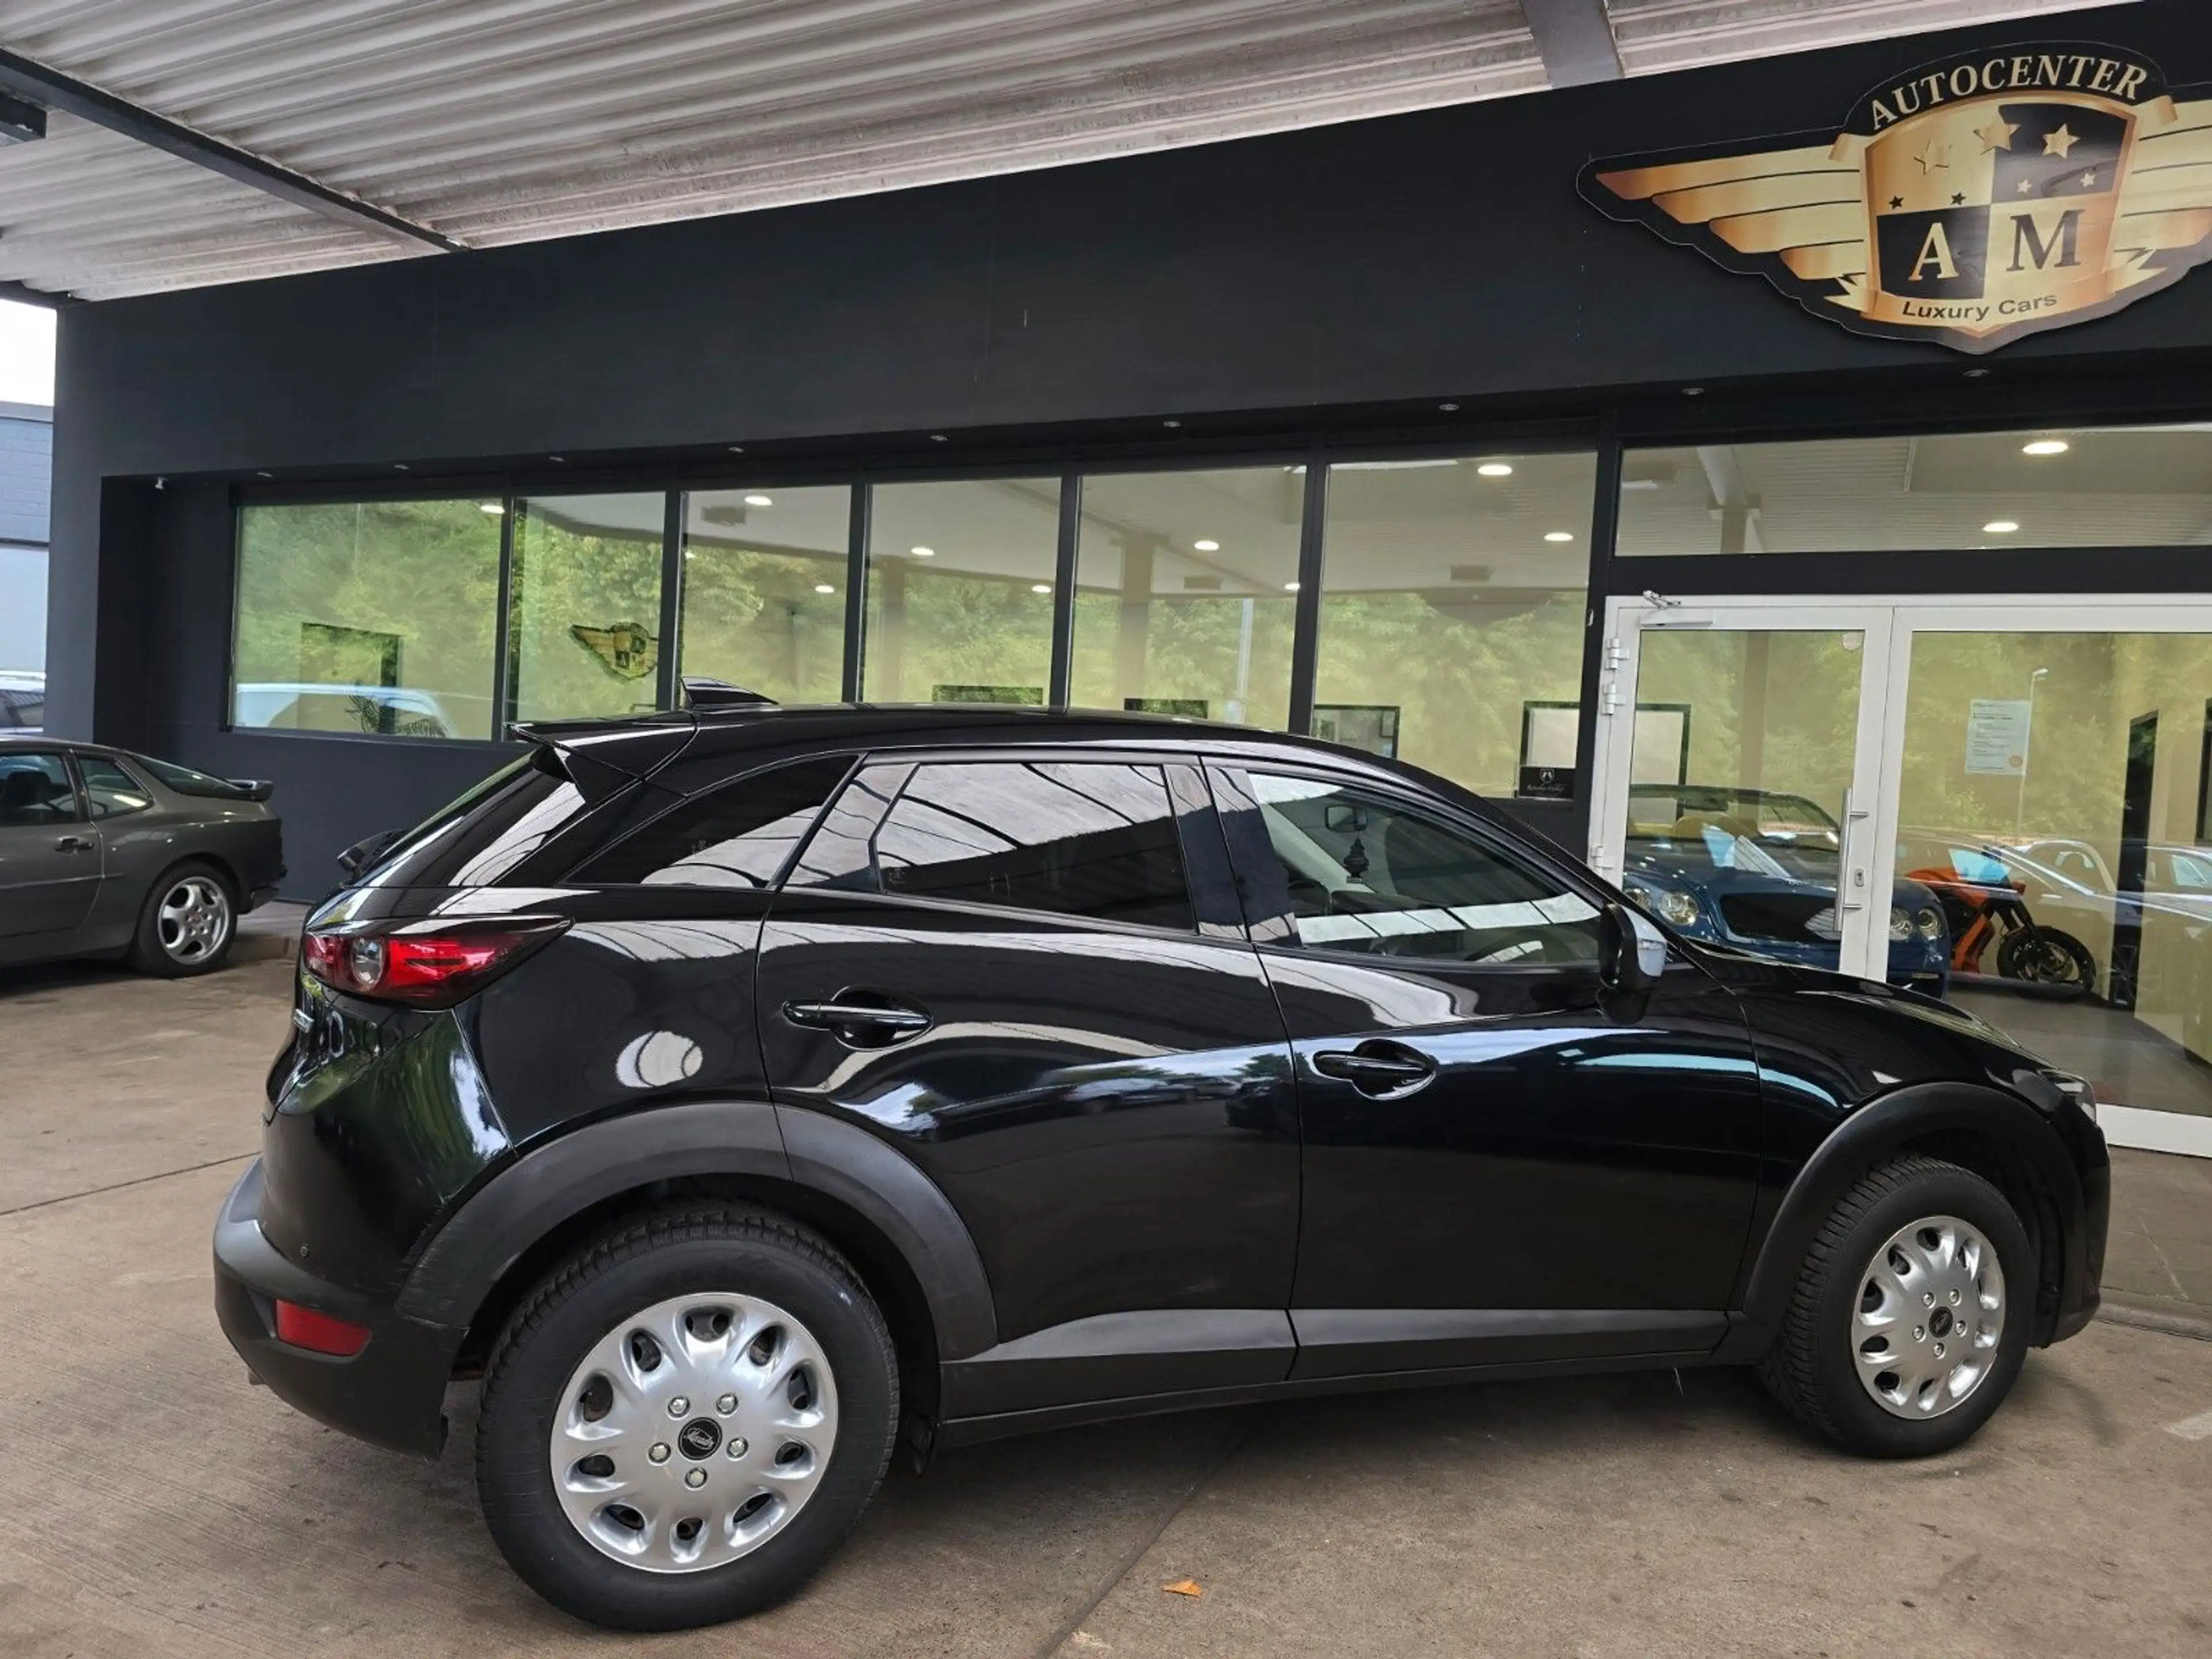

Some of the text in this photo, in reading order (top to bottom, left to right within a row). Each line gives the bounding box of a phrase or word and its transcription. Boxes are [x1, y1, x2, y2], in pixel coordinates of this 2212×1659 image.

[1872, 55, 2147, 130] AUTOCENTER
[1908, 209, 2086, 281] A M
[1902, 294, 2058, 321] Luxury Cars
